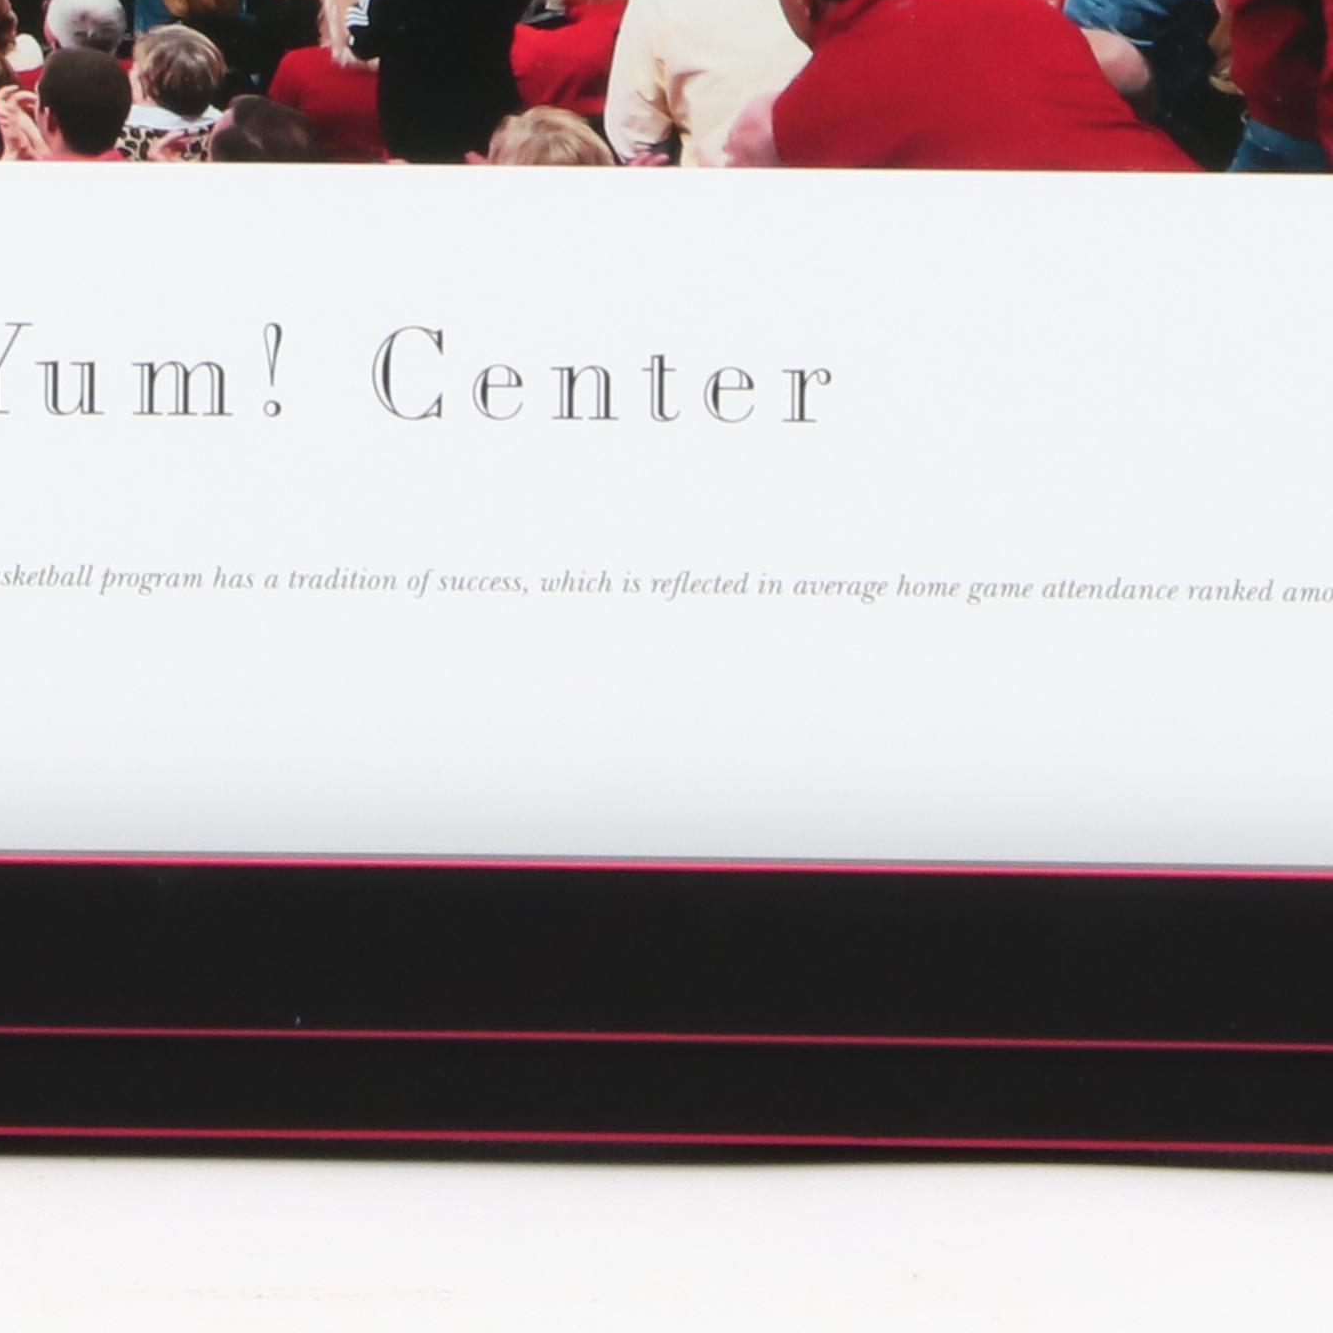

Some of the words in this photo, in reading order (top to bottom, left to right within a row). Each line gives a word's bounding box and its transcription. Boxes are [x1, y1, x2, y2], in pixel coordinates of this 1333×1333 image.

[372, 327, 831, 422] Center
[99, 568, 202, 595] program
[213, 566, 254, 588] has
[264, 574, 278, 589] a
[289, 567, 396, 590] tradition
[407, 569, 441, 598] of
[439, 576, 528, 594] success,
[541, 570, 611, 593] which
[623, 572, 640, 593] is
[651, 571, 749, 601] reflected
[758, 573, 782, 594] in
[793, 581, 888, 604] average
[897, 574, 960, 597] home
[967, 583, 1033, 605] game
[1042, 577, 1178, 600] attendance
[1188, 579, 1274, 601] ranked
